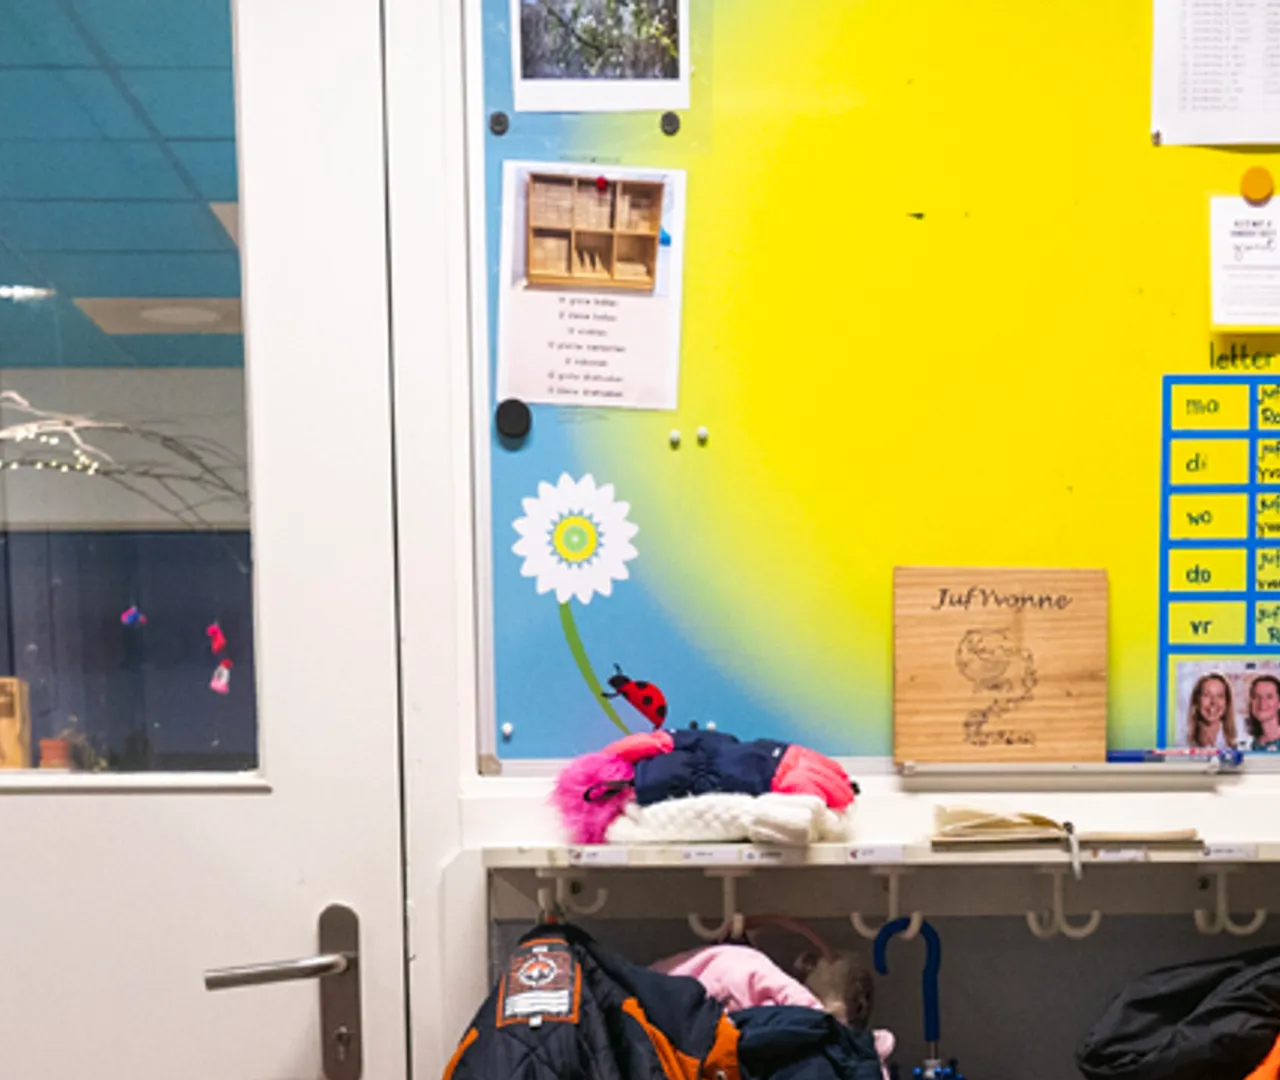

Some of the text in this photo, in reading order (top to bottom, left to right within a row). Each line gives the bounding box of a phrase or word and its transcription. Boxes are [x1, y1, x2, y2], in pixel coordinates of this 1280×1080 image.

[1210, 341, 1272, 370] letter
[1186, 510, 1212, 526] wo
[1186, 563, 1212, 585] do
[931, 586, 1073, 611] Juf Yvonne
[1189, 619, 1213, 635] vr
